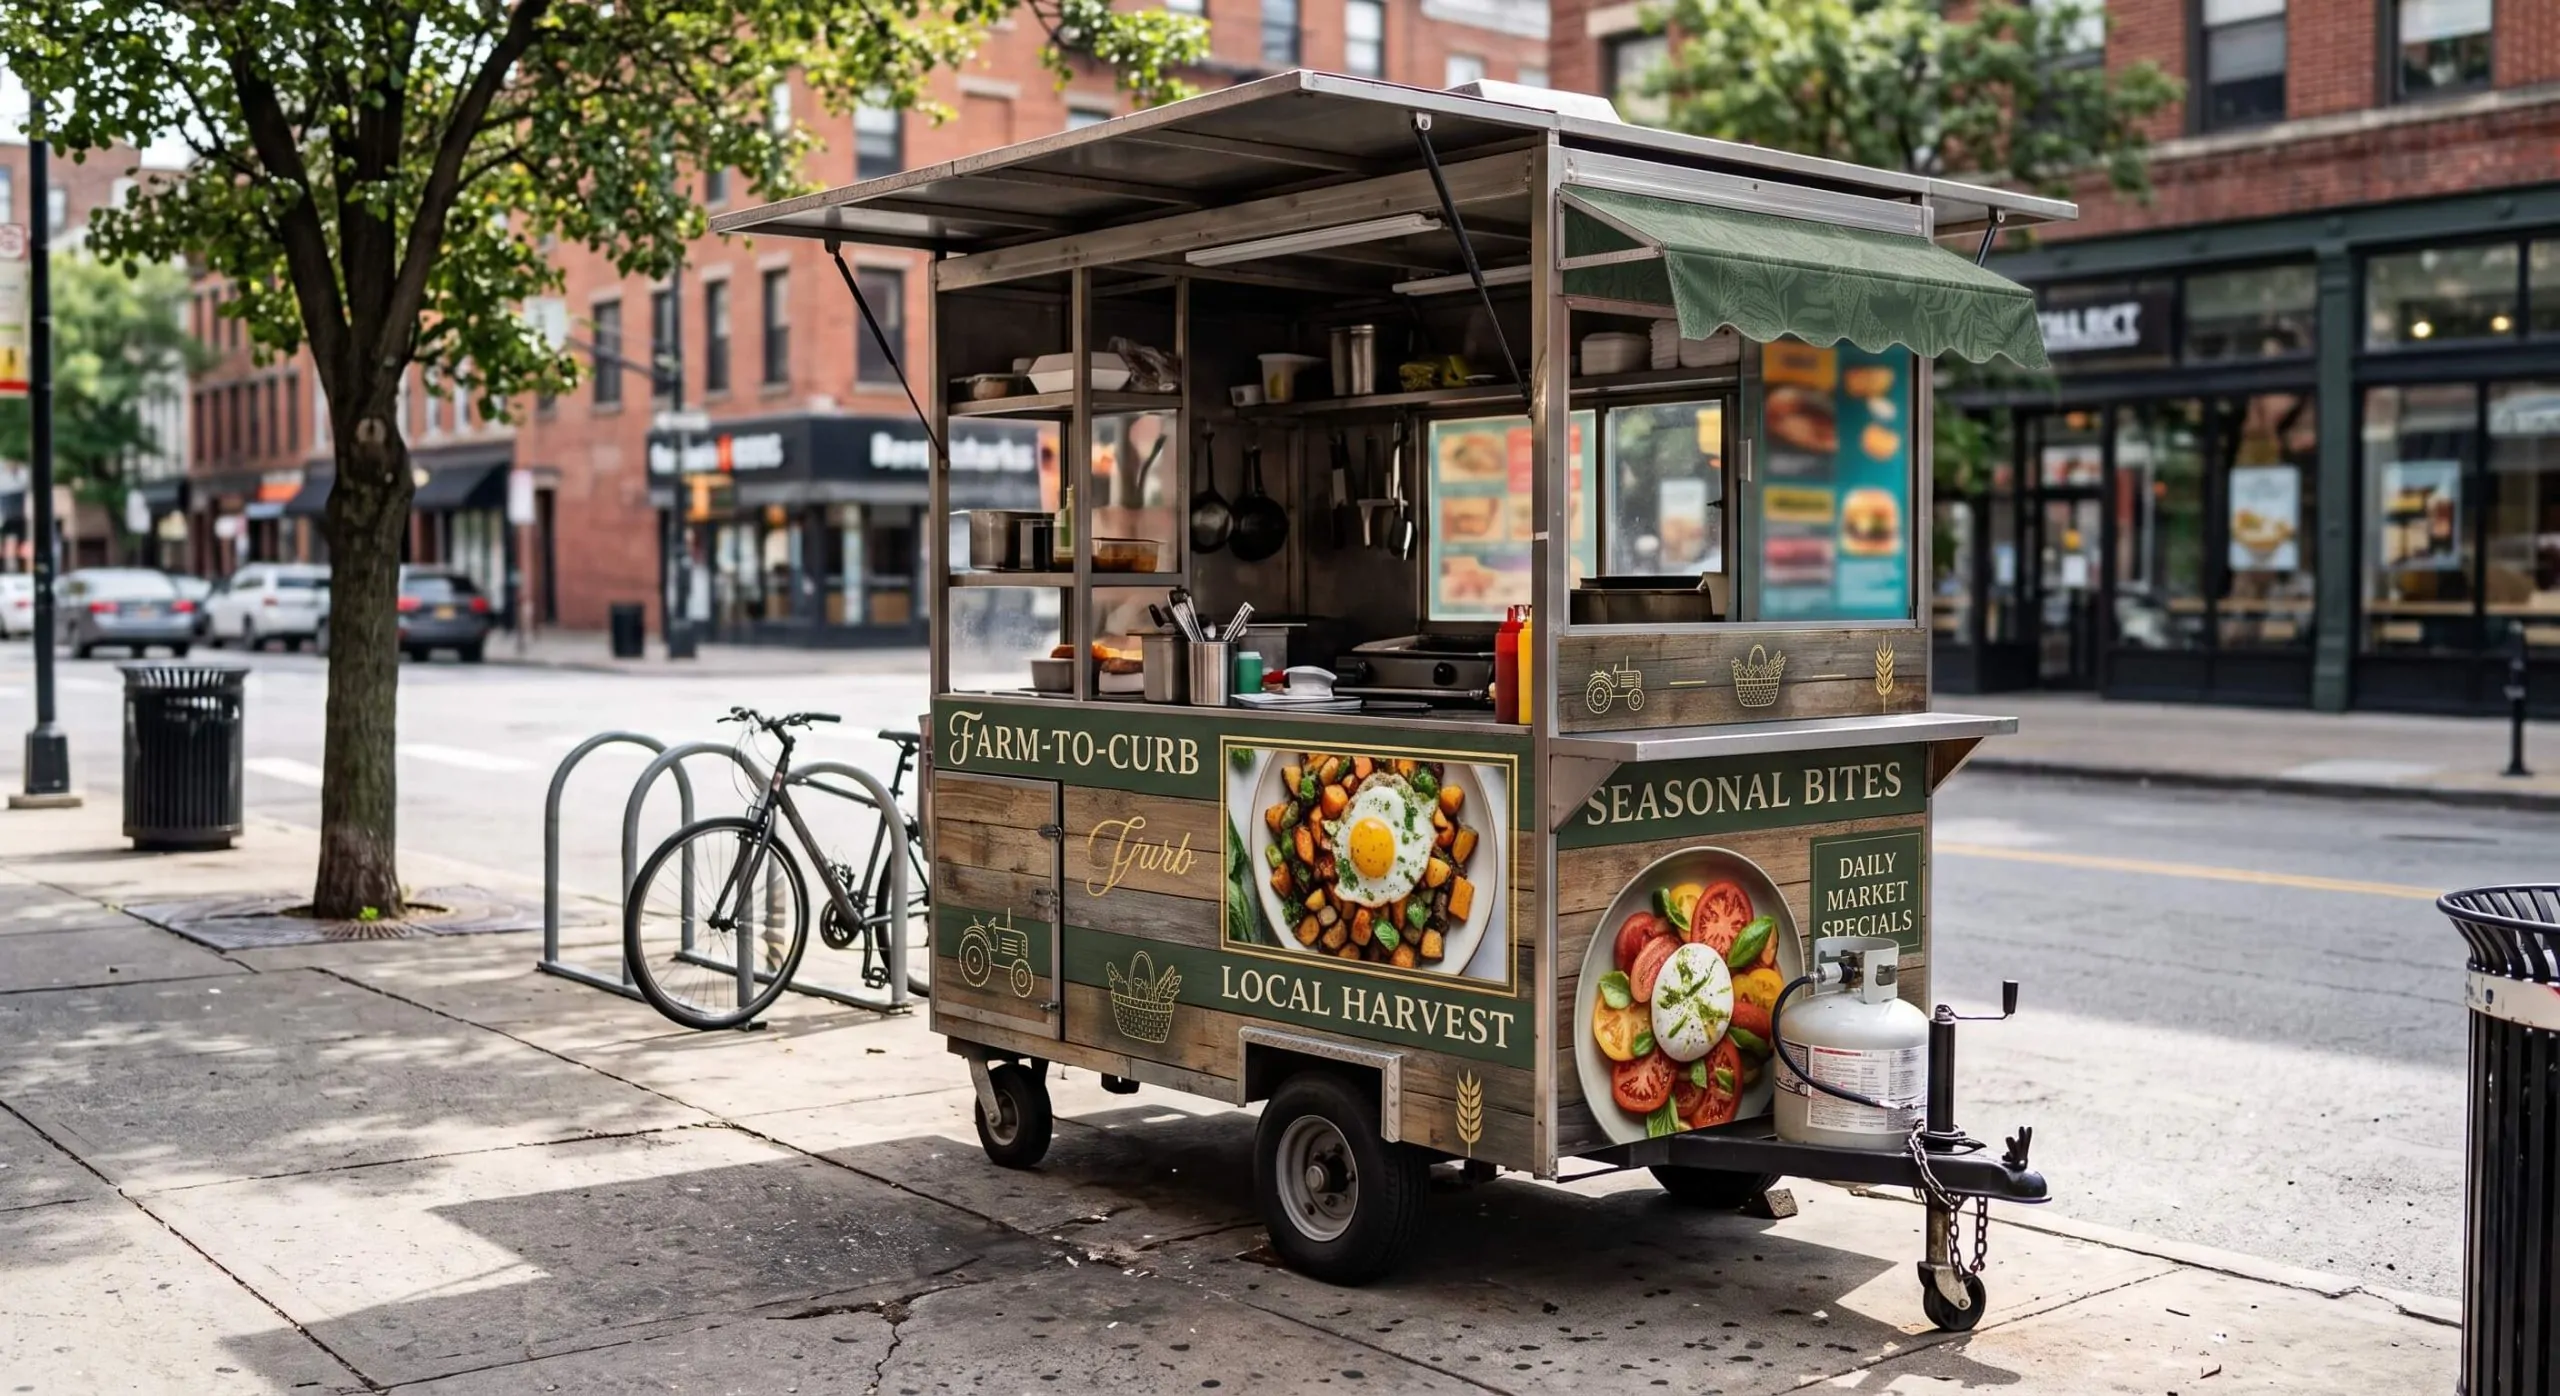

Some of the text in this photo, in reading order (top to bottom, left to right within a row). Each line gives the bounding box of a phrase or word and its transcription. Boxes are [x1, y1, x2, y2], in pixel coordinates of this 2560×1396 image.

[949, 710, 1200, 775] FARM-TO-CURB
[1587, 761, 1902, 826] SEASONAL BITES
[1839, 852, 1897, 880] DAILY
[1827, 880, 1909, 912] MARKET
[1821, 909, 1913, 938] SPECIALS
[1221, 965, 1515, 1049] LOCAL HARVEST
